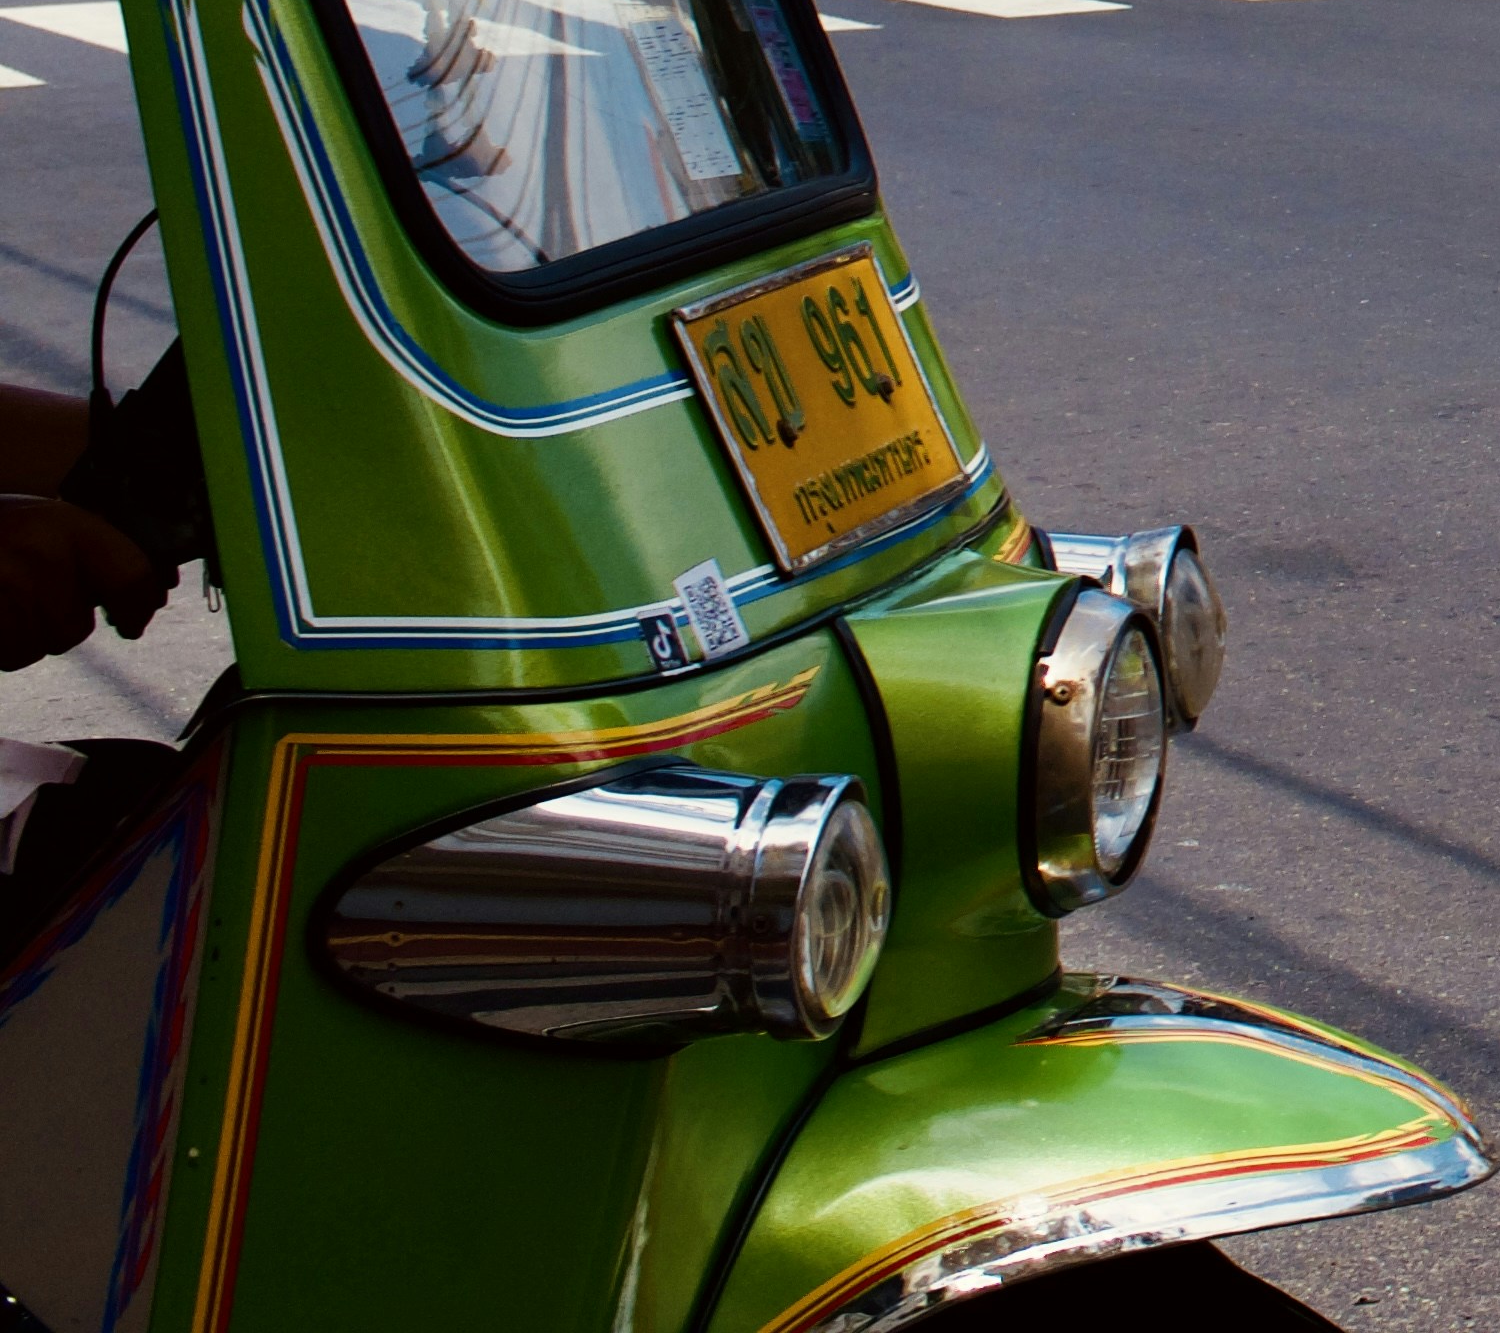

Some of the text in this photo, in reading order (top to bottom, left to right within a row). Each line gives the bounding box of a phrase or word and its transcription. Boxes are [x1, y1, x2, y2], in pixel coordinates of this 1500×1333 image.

[801, 276, 904, 407] 961
[793, 429, 932, 534] กรุงเทพมหานคร
